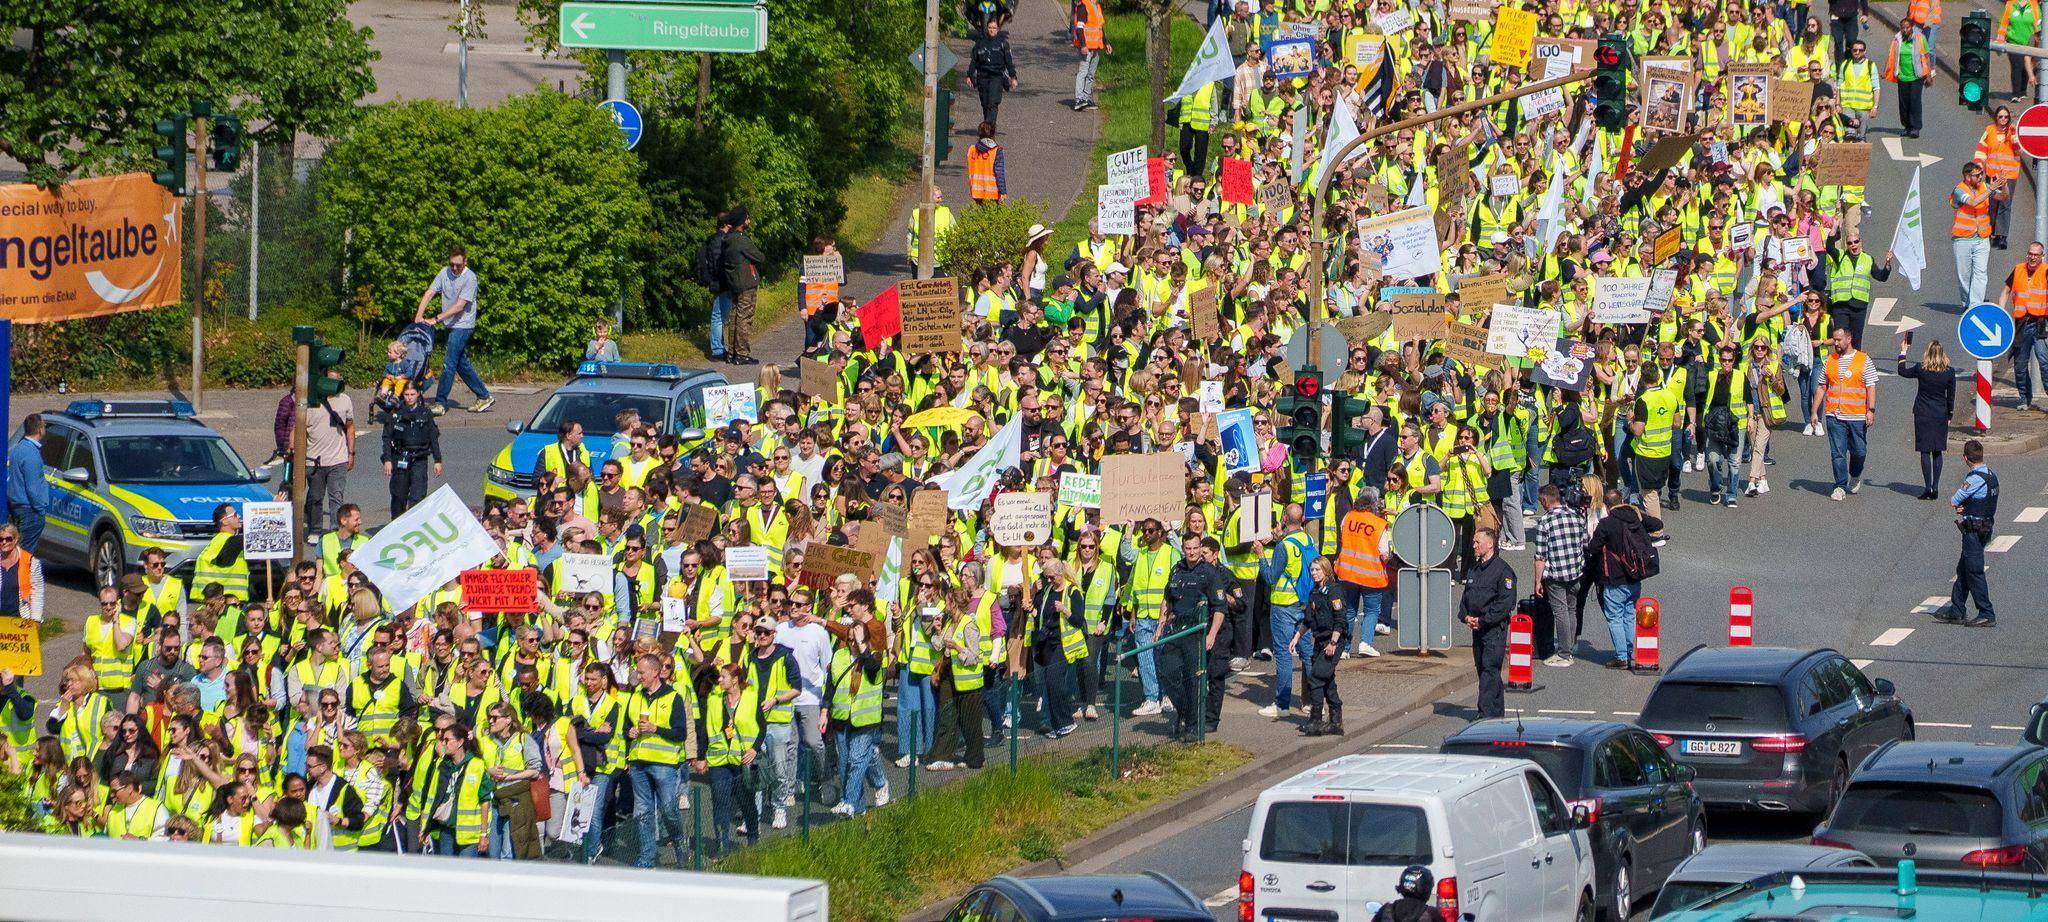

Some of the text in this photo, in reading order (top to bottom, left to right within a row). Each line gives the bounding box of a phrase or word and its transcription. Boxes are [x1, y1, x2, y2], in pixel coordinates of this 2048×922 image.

[653, 20, 750, 39] Ringeltaube
[1292, 24, 1311, 33] Ohne
[1538, 44, 1560, 58] 100
[1114, 149, 1142, 167] GUTE
[0, 198, 98, 218] ecial way to buy.
[1101, 209, 1134, 219] ZUKUNFT
[0, 217, 158, 281] ngeltaube
[900, 282, 915, 291] Erst
[1602, 282, 1645, 293] 100 JAHRE
[0, 295, 18, 306] ier
[21, 295, 40, 305] um
[43, 292, 57, 303] die
[1393, 299, 1445, 316] Sozialplan
[903, 323, 918, 332] Ein
[179, 496, 252, 504] POLIZEI
[997, 498, 1006, 506] Es
[1060, 489, 1101, 504] MITEINAND
[1119, 501, 1183, 517] MANAGEMENT
[1006, 521, 1023, 531] Gold
[1348, 520, 1375, 536] UFO
[832, 547, 872, 568] GIER
[464, 573, 489, 584] IMMER
[494, 594, 510, 606] MIT
[0, 632, 29, 642] ANDELT
[1690, 741, 1736, 753] GG C 827
